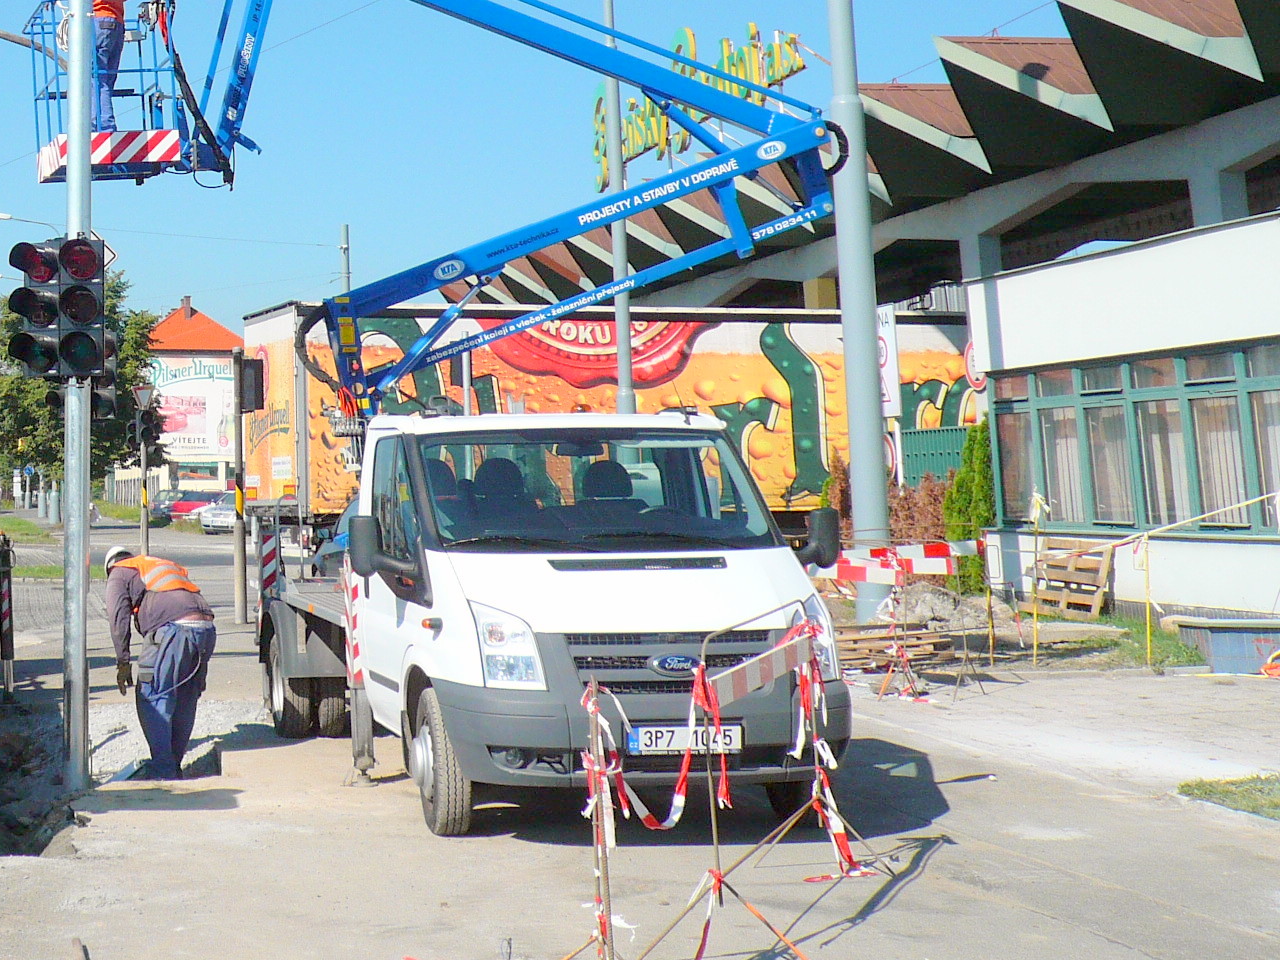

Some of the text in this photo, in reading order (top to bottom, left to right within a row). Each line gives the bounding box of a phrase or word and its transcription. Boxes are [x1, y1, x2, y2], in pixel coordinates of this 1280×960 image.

[763, 144, 780, 157] KTA
[577, 158, 739, 226] PROJEKTY A STAVBY V DOPRAVĚ
[752, 209, 817, 240] 378 0234 11
[486, 228, 560, 259] www.kta-technika.cz
[440, 263, 458, 276] KTA
[426, 335, 484, 363] zabezpečení
[483, 326, 509, 341] kolejí
[516, 311, 547, 329] vleček
[551, 294, 596, 316] železniční
[596, 279, 635, 301] přejezdy
[541, 320, 612, 345] ROKU
[148, 357, 234, 387] Pilsner Urquel
[172, 436, 208, 444] VÍTEJTE
[249, 400, 290, 455] Pilsner Urquell
[665, 657, 693, 670] Ford
[643, 730, 676, 748] 3P7
